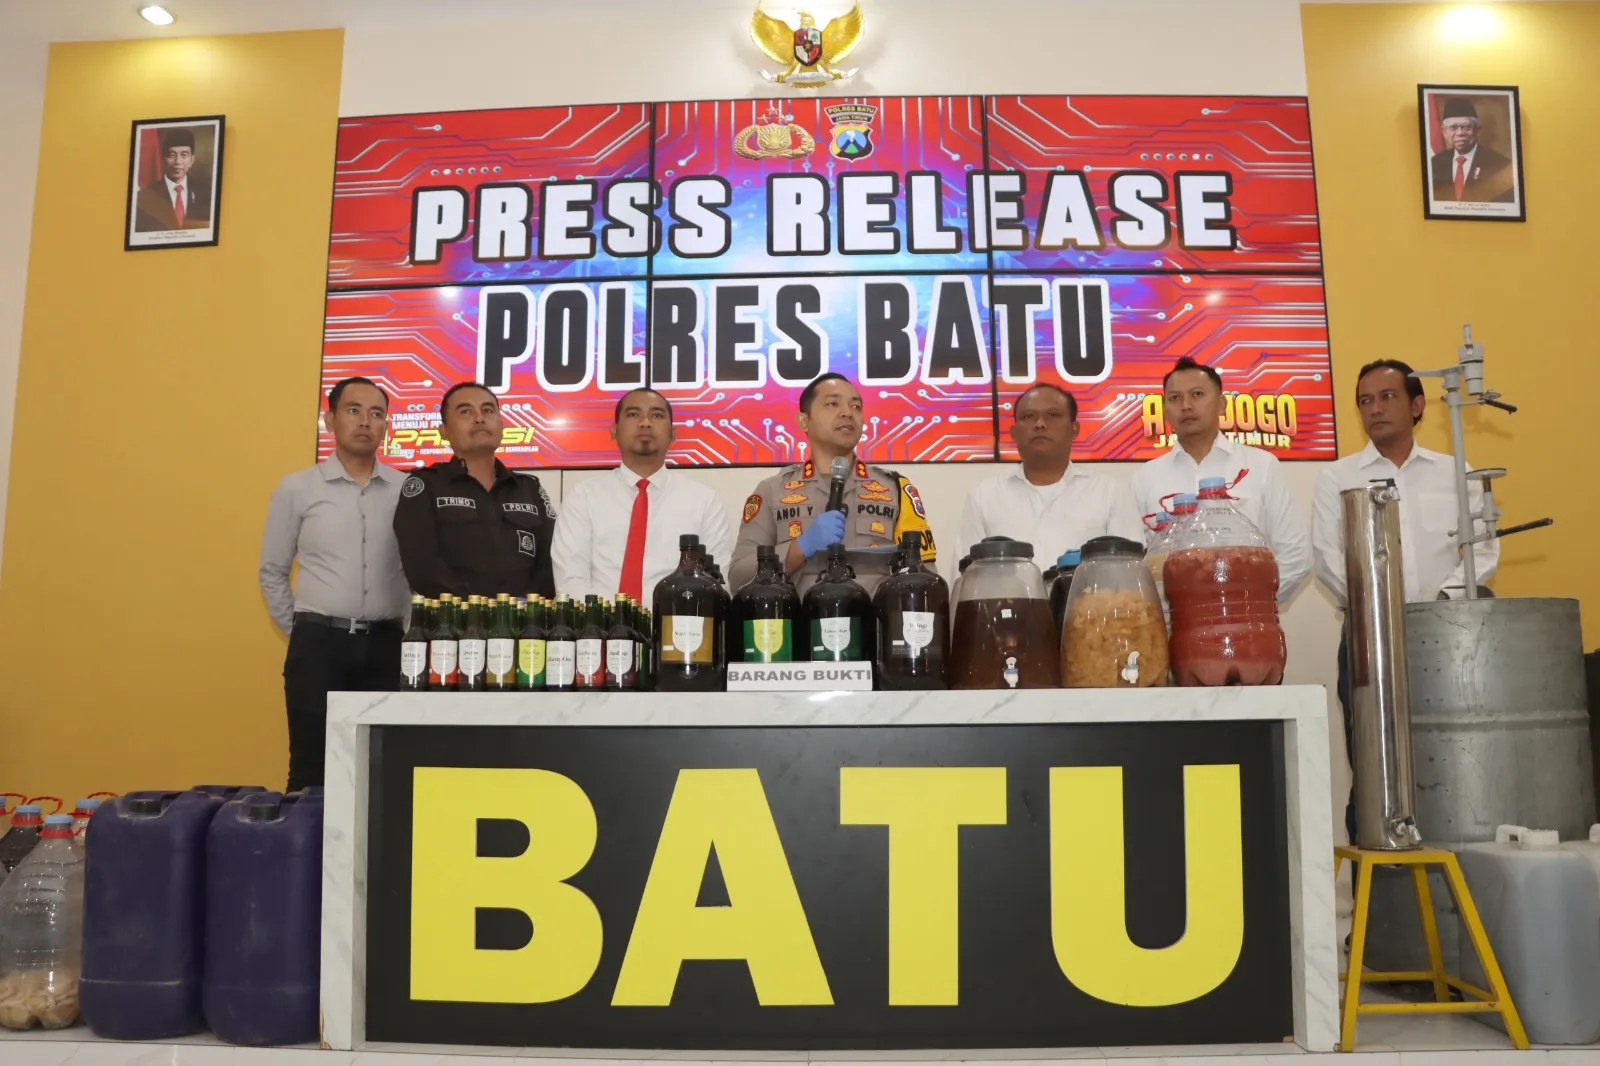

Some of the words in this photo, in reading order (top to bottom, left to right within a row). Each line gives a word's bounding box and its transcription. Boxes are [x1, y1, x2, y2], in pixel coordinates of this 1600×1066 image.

[828, 106, 856, 114] POLRES
[857, 106, 874, 114] BATU
[409, 174, 732, 265] PRESS
[767, 170, 1238, 256] RELEASE
[476, 276, 829, 393] POLRES
[858, 275, 1112, 386] BATU
[1225, 431, 1291, 448] TIMUR
[444, 498, 471, 506] TRIMO
[510, 503, 534, 512] POLRI
[776, 506, 800, 521] ANDI
[807, 506, 814, 516] Y
[858, 504, 894, 520] POLRI
[727, 670, 807, 682] BARANG
[813, 669, 871, 681] BUKTI
[409, 764, 1245, 1008] BATU
